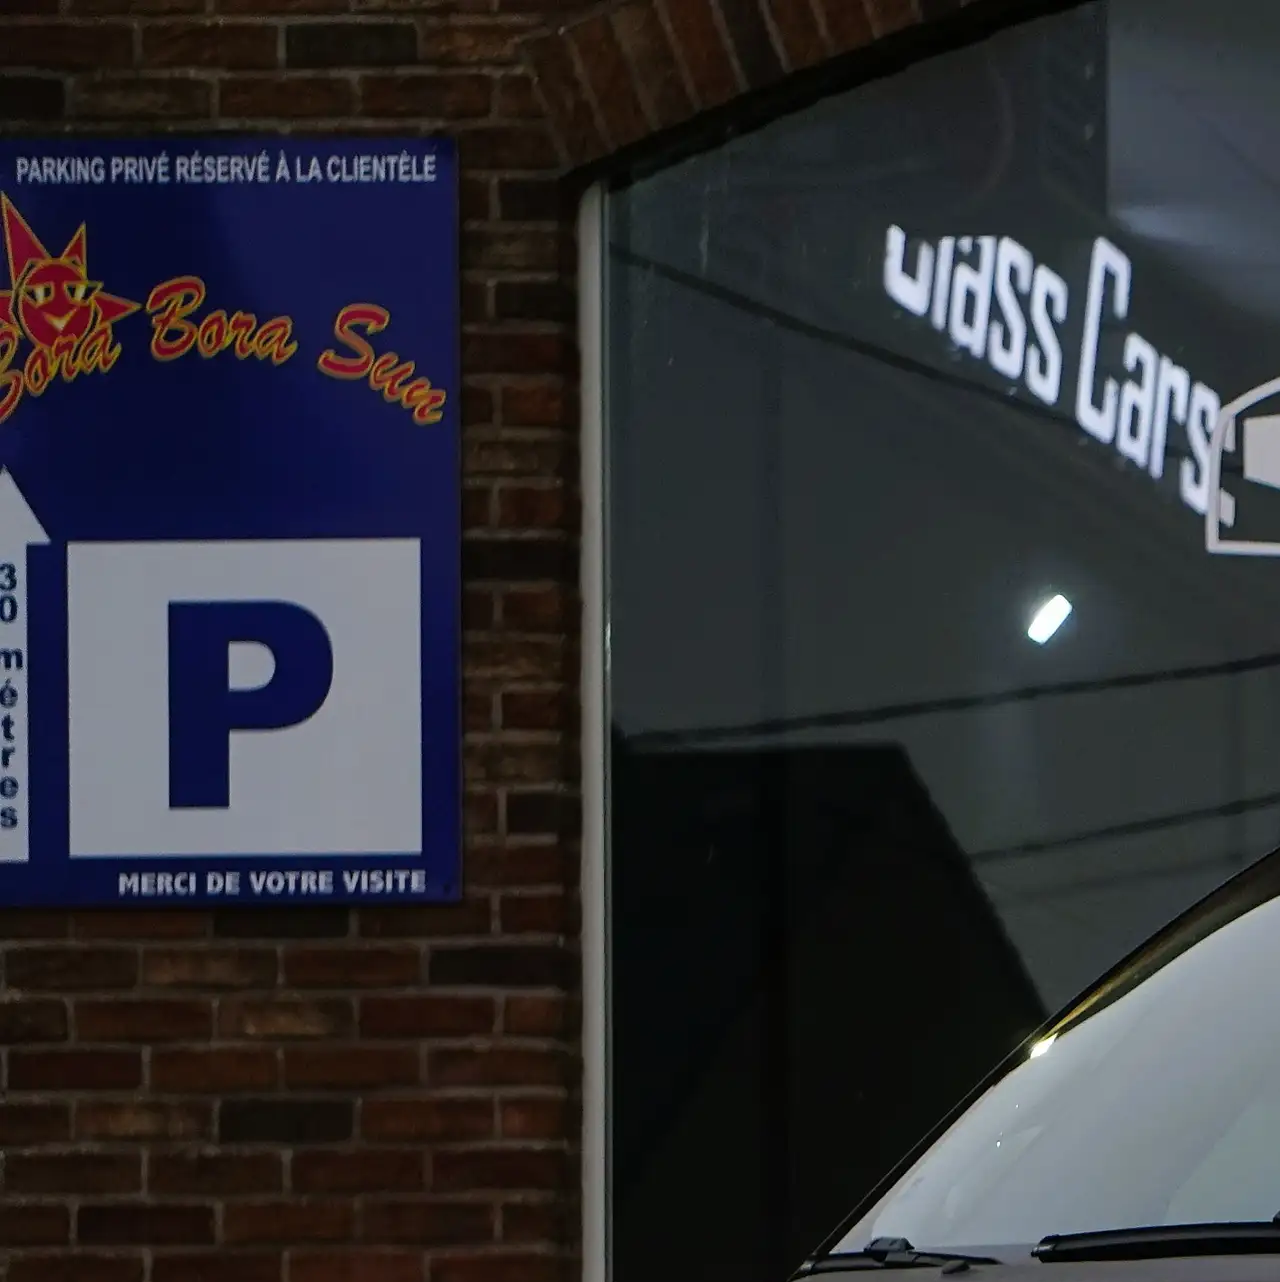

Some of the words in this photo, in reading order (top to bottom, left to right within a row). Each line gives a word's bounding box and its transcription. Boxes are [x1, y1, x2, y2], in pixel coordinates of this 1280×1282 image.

[16, 156, 106, 184] PARKING
[111, 150, 169, 184] PRIVÉ
[176, 149, 270, 184] RÉSERVÉ
[275, 149, 291, 183] À
[296, 156, 323, 183] LA
[326, 150, 436, 183] CLIENTÈLE
[146, 275, 298, 366] Bora
[317, 303, 446, 425] Sun
[168, 600, 333, 810] P
[118, 872, 196, 895] MERCI
[206, 872, 240, 894] DE
[249, 870, 334, 894] VOTRE
[342, 870, 426, 893] VISITE
